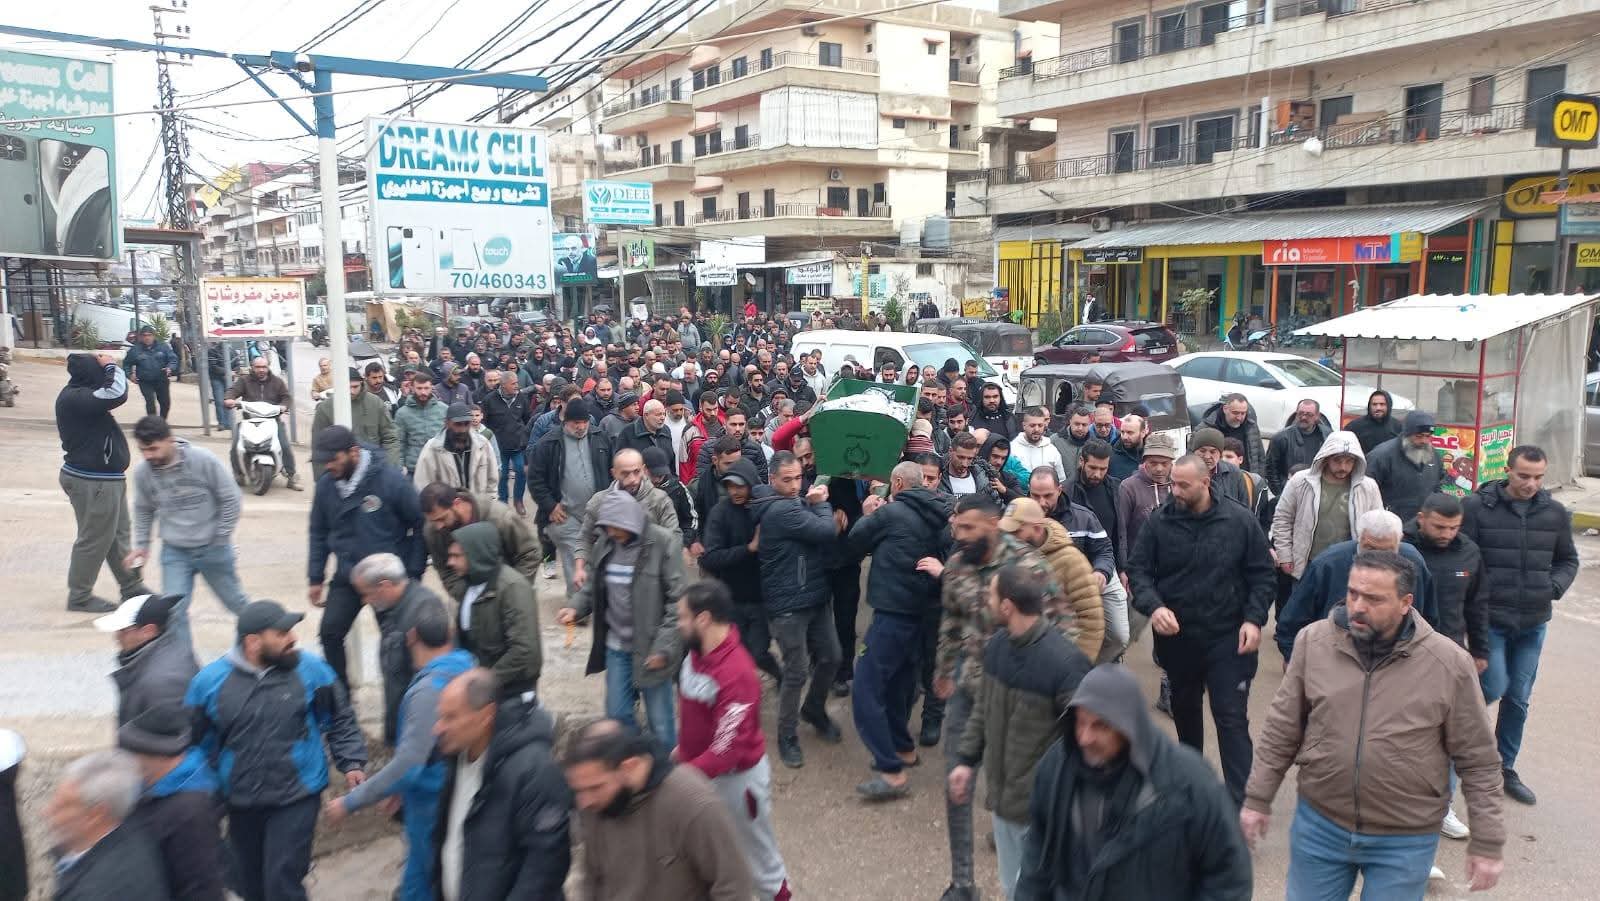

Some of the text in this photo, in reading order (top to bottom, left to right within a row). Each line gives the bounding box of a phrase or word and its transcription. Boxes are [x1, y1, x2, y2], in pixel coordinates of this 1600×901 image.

[1561, 109, 1592, 134] OMT
[378, 125, 543, 177] DREAMS CELL
[485, 246, 509, 257] touch
[1273, 242, 1301, 262] ria
[450, 273, 546, 289] 70/460343
[208, 285, 299, 303] معرض مفروشات
